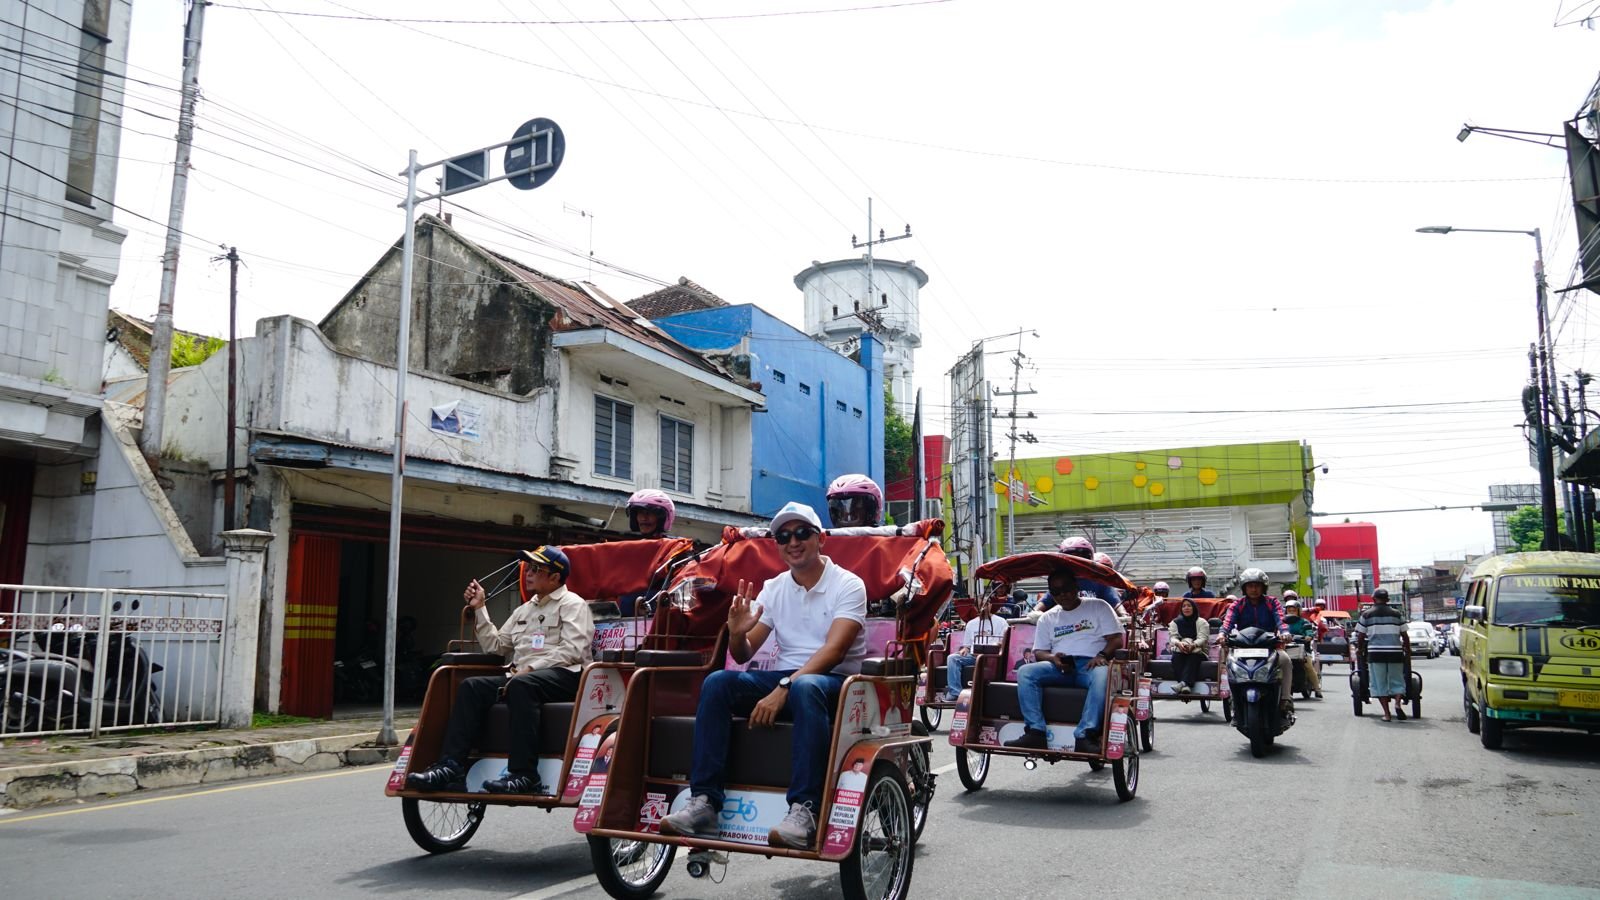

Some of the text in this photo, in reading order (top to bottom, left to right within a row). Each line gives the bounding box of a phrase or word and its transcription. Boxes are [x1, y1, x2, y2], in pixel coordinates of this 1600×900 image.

[602, 627, 626, 639] BARU
[1568, 637, 1598, 648] 146
[831, 817, 854, 825] INDONESIA
[723, 823, 745, 831] BECAK
[719, 831, 753, 840] PRABOWO
